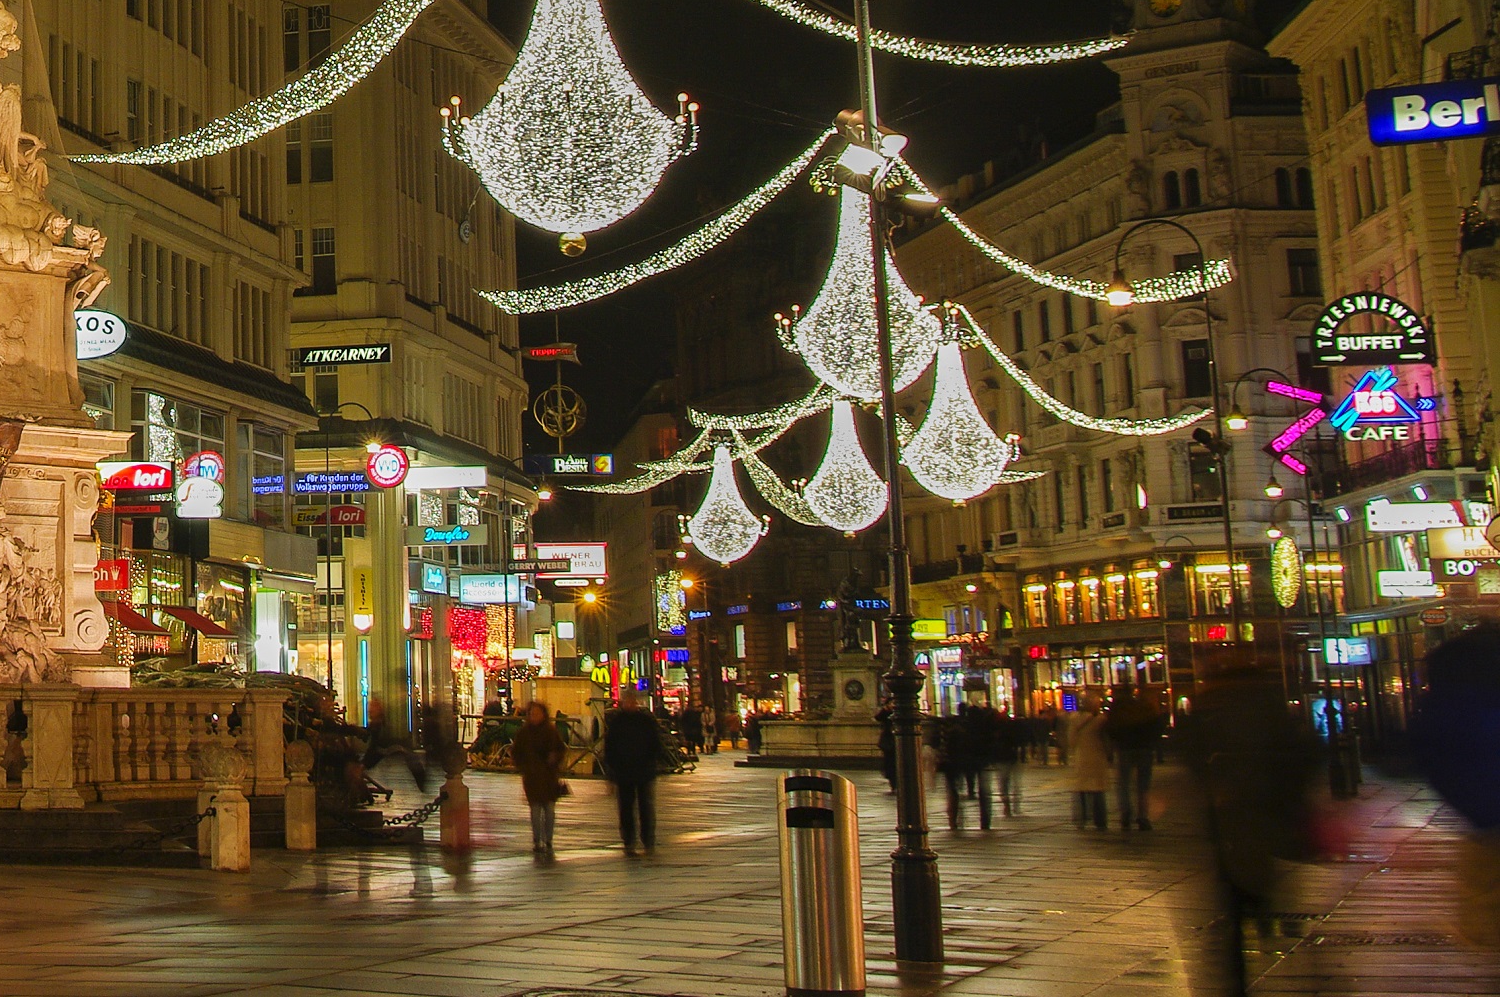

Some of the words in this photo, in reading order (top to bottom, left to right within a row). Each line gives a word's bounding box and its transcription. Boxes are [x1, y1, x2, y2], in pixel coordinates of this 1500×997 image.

[1336, 335, 1404, 351] BUFFET
[1344, 426, 1410, 441] CAFE
[306, 473, 319, 483] für
[319, 473, 349, 484] Kunden
[350, 473, 365, 483] der
[424, 525, 470, 544] Douglas
[551, 552, 591, 560] WIENER
[508, 562, 536, 571] GERRY
[537, 561, 568, 571] WEBER
[471, 580, 495, 588] World
